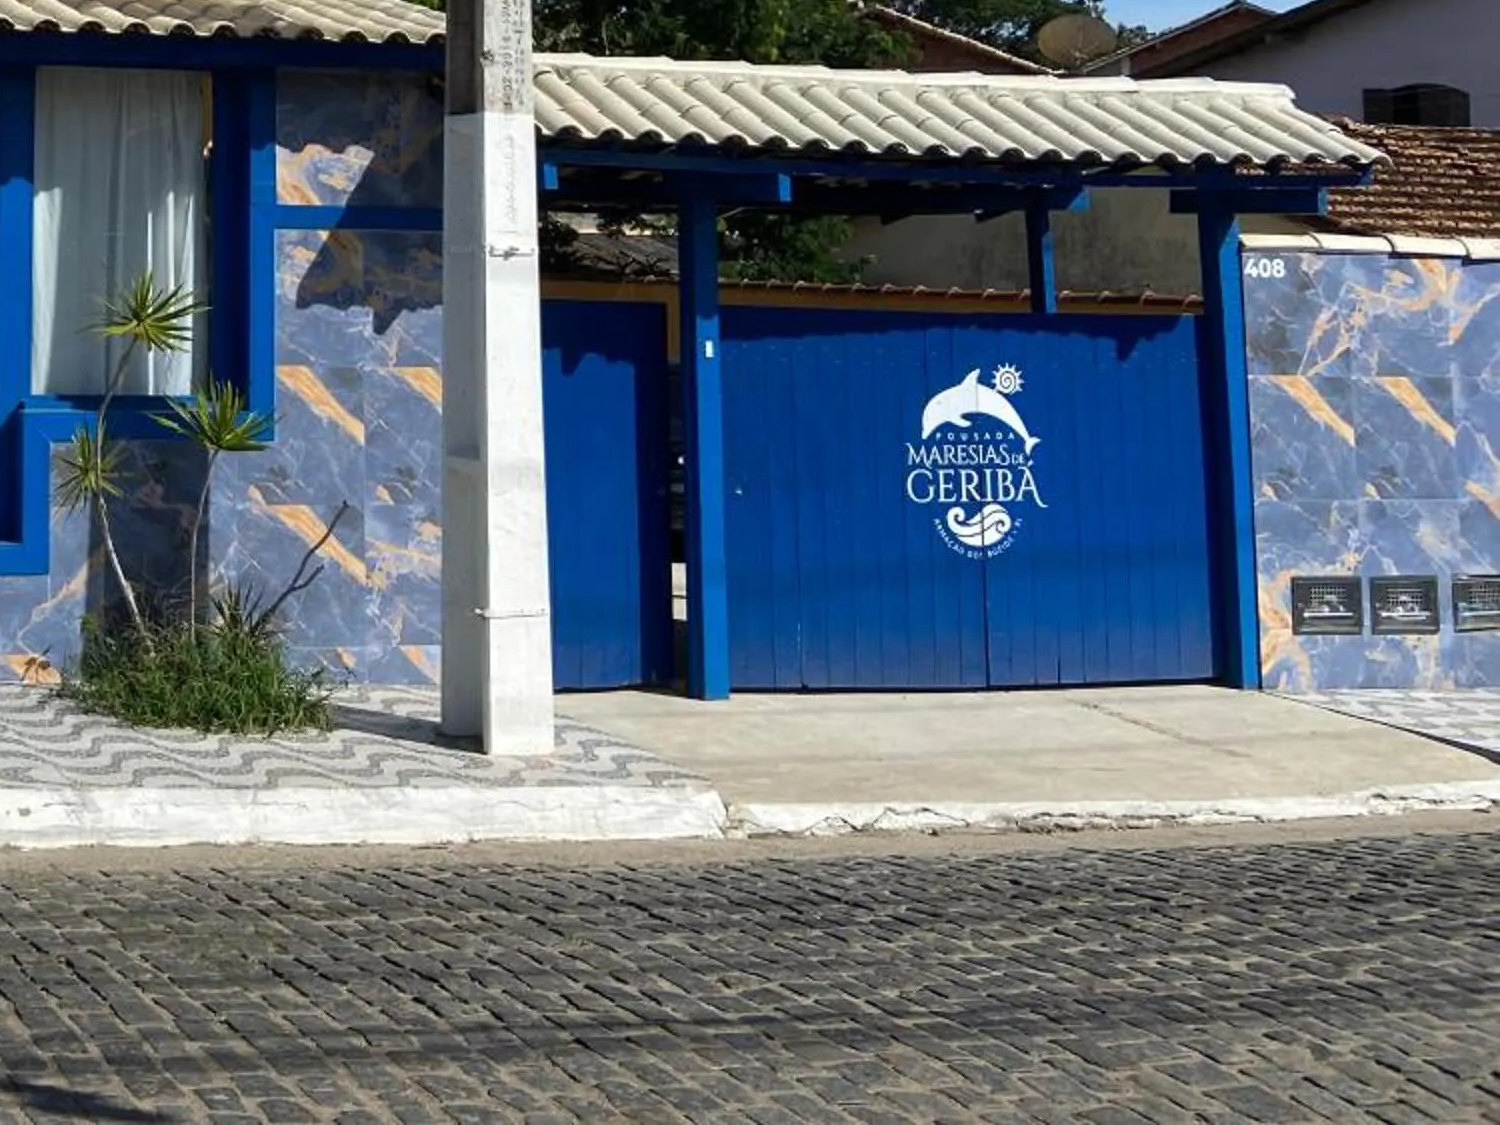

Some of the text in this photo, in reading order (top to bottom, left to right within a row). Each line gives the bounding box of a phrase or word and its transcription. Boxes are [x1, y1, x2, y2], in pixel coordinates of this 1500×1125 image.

[1244, 259, 1285, 277] 408
[936, 432, 1015, 441] POUSADA
[905, 442, 1011, 470] MARESIAS
[907, 461, 1048, 507] GERIBÁ
